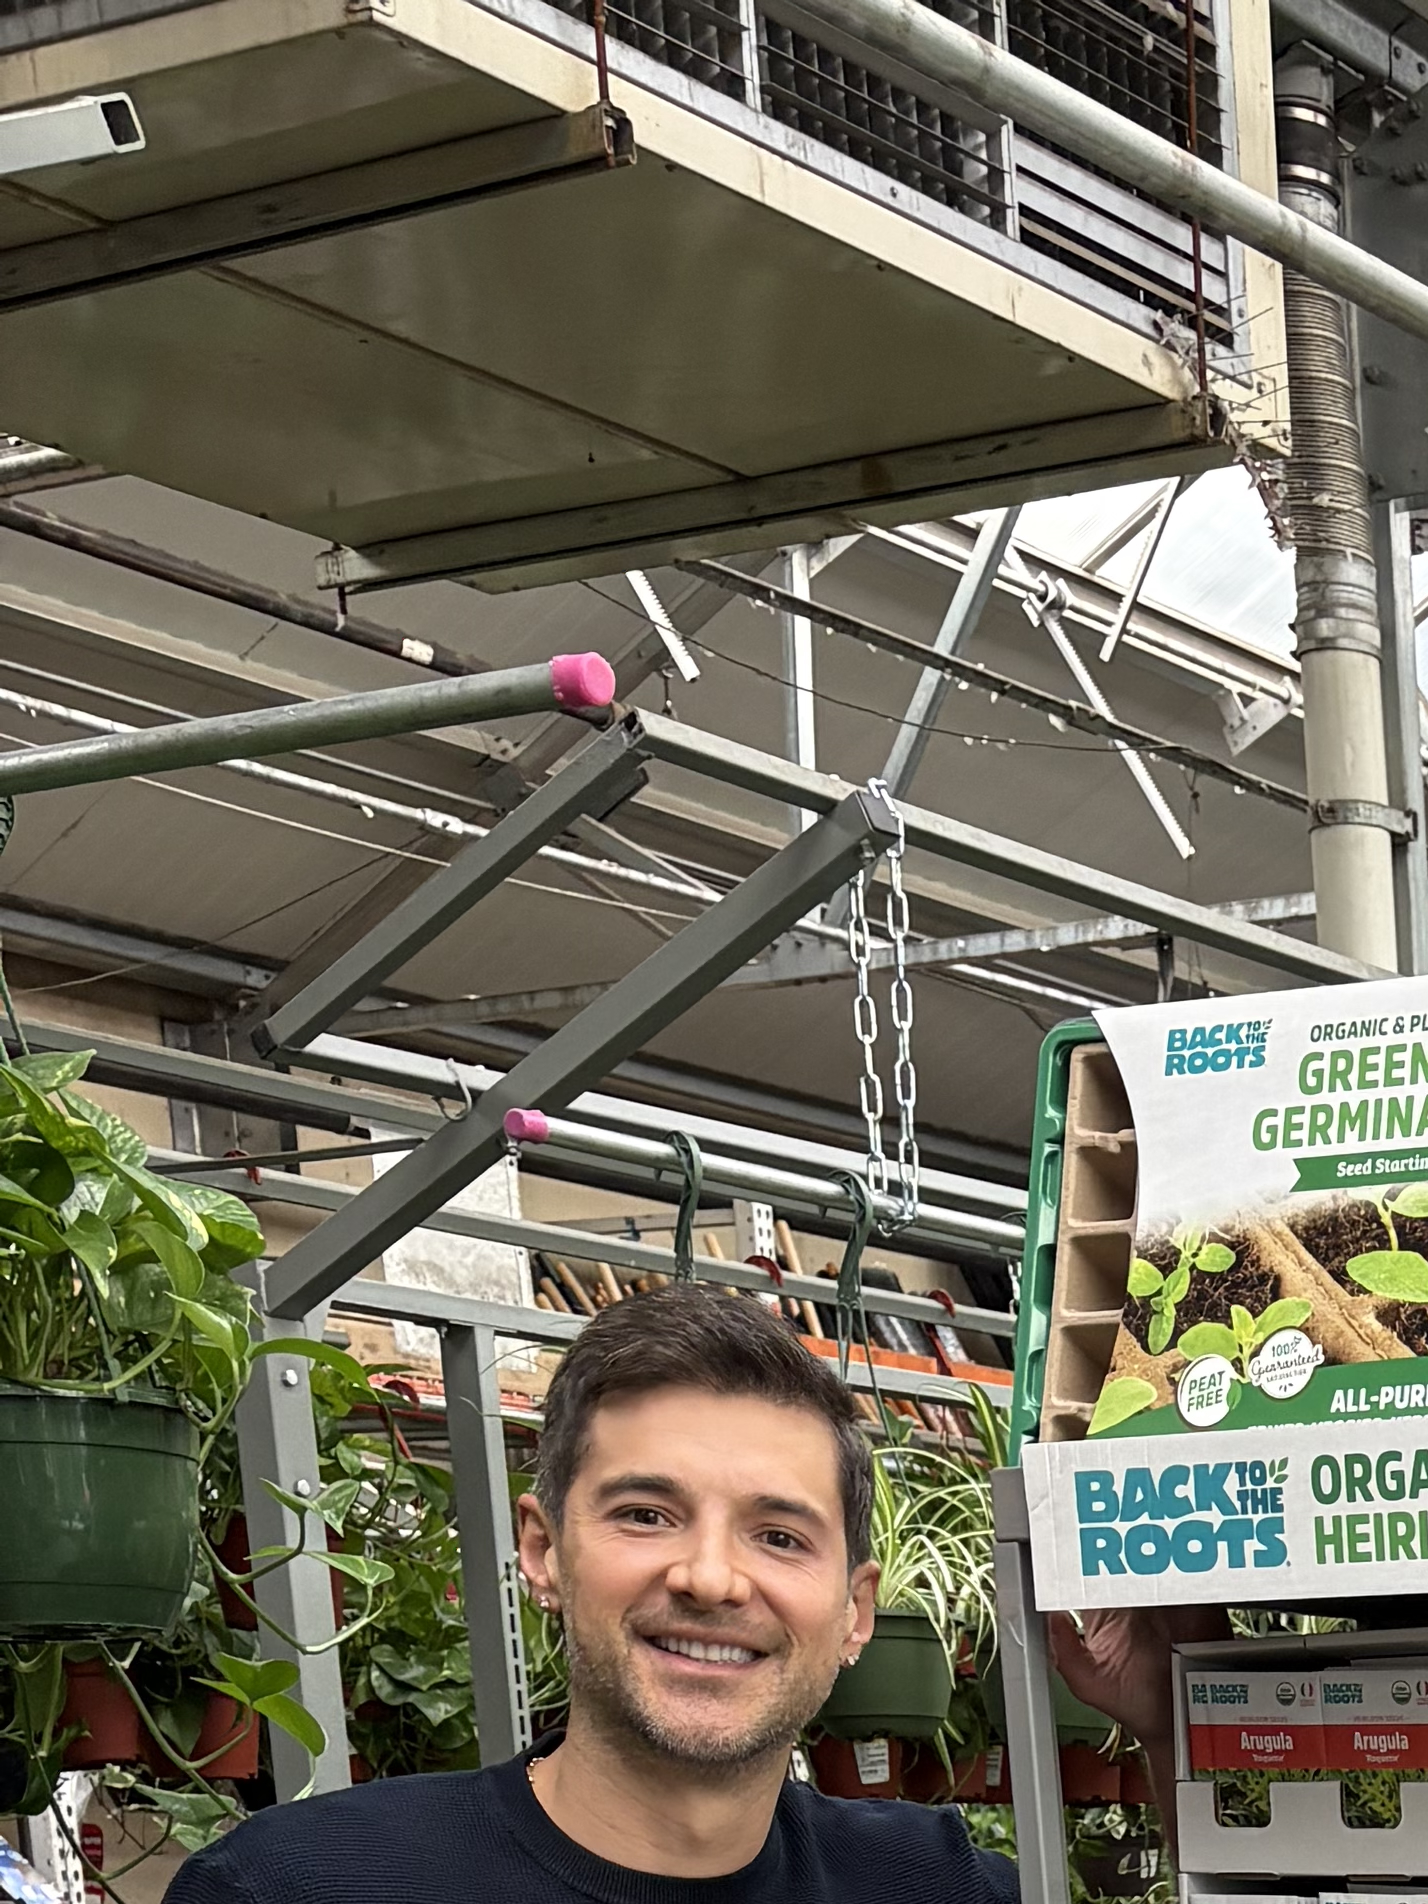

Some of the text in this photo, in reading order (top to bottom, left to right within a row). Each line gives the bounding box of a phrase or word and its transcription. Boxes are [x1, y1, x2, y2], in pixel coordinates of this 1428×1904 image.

[1167, 1025, 1243, 1052] BACK
[1311, 1018, 1388, 1042] ORGANIC
[1393, 1016, 1404, 1034] &
[1166, 1045, 1263, 1074] ROOTS
[1337, 1159, 1372, 1177] Seed
[1188, 1370, 1225, 1395] PEAT
[1187, 1388, 1223, 1412] FREE
[1076, 1463, 1282, 1524] BACK TO THE
[1078, 1516, 1285, 1575] ROOTS
[1241, 1732, 1293, 1752] Arugula
